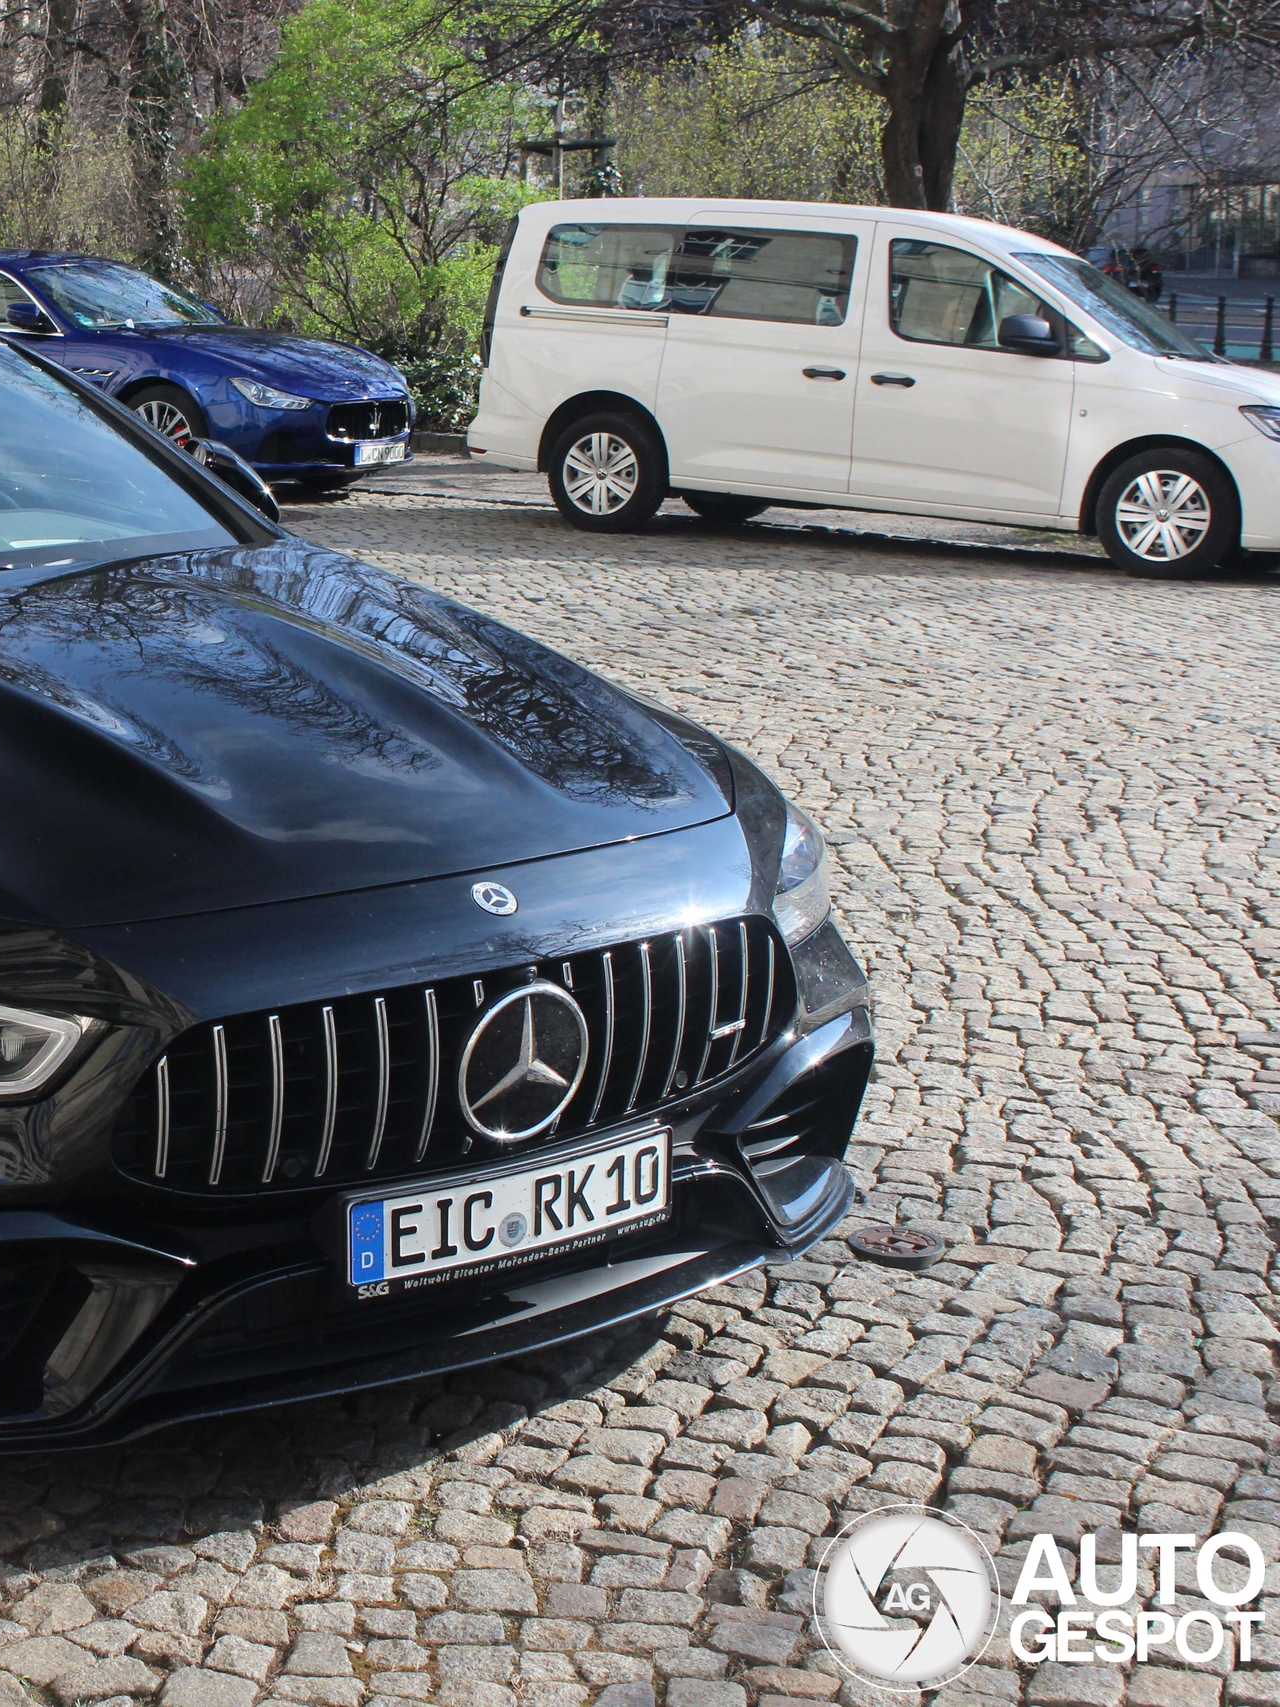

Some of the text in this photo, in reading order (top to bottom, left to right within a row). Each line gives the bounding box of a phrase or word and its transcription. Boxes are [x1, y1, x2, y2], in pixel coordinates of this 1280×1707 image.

[392, 1190, 496, 1268] EIC
[534, 1163, 595, 1236] RK
[606, 1145, 659, 1216] 10
[497, 1243, 571, 1269] Mercedes-Benz
[572, 1232, 607, 1250] Partner
[617, 1212, 666, 1236] www.sug.de
[361, 1251, 374, 1269] D
[357, 1281, 390, 1300] S&G
